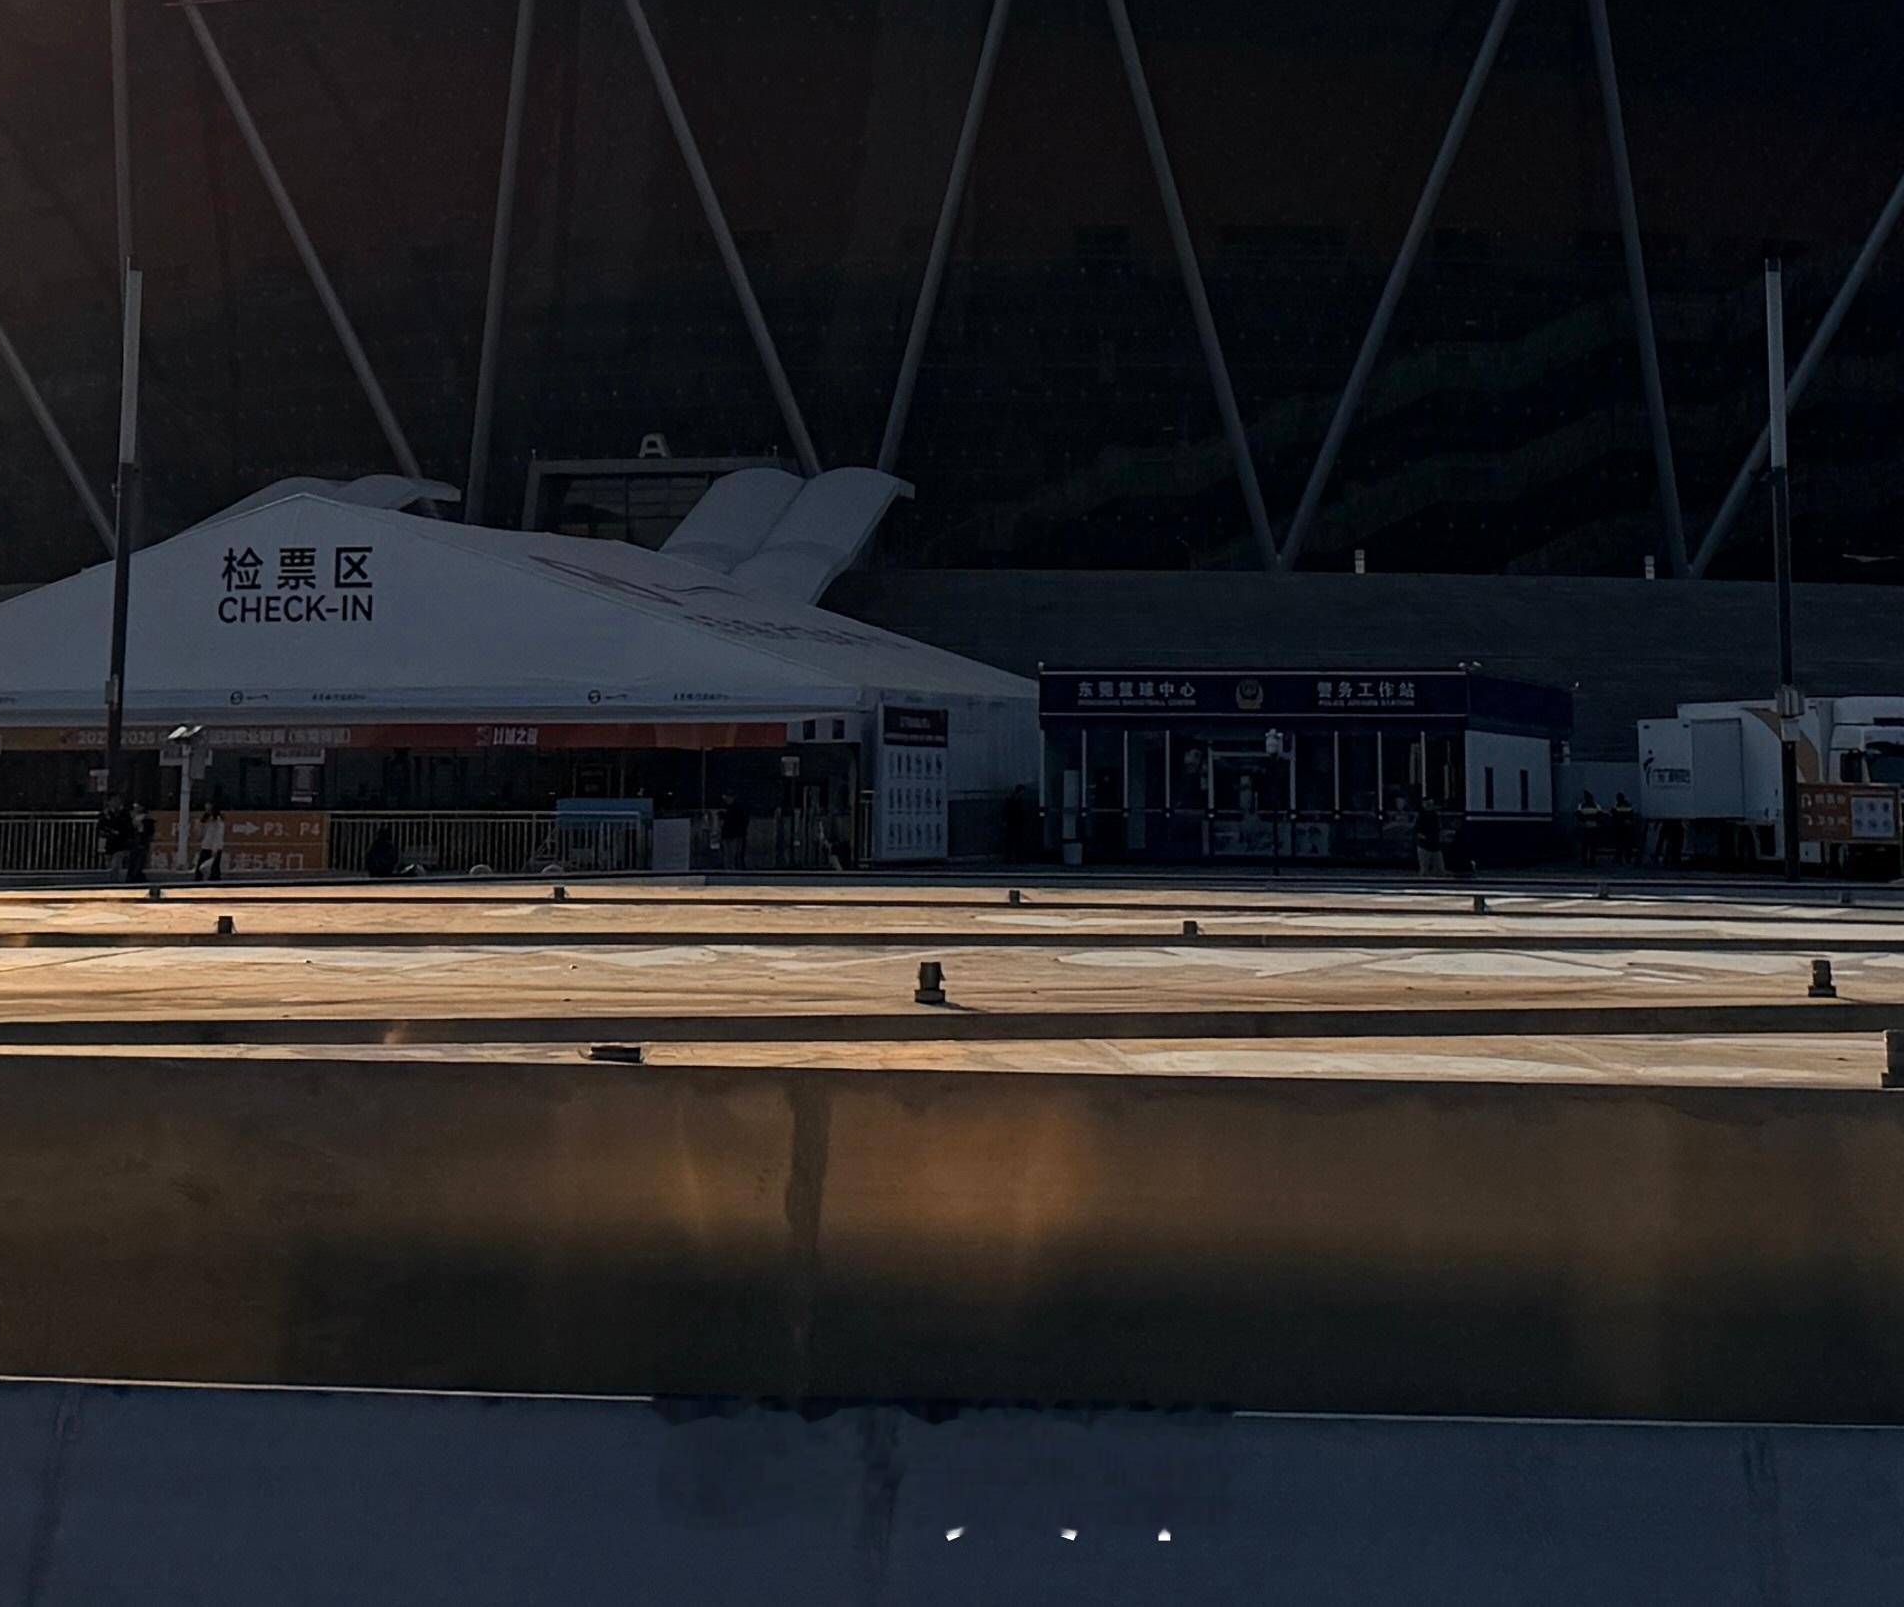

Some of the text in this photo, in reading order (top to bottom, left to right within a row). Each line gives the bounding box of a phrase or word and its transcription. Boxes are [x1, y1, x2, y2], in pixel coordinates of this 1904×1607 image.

[222, 547, 373, 592] 检票区
[218, 595, 373, 624] CHECK-IN
[1078, 680, 1196, 698] 东莞篮球中心
[1317, 680, 1416, 698] 警务工作站
